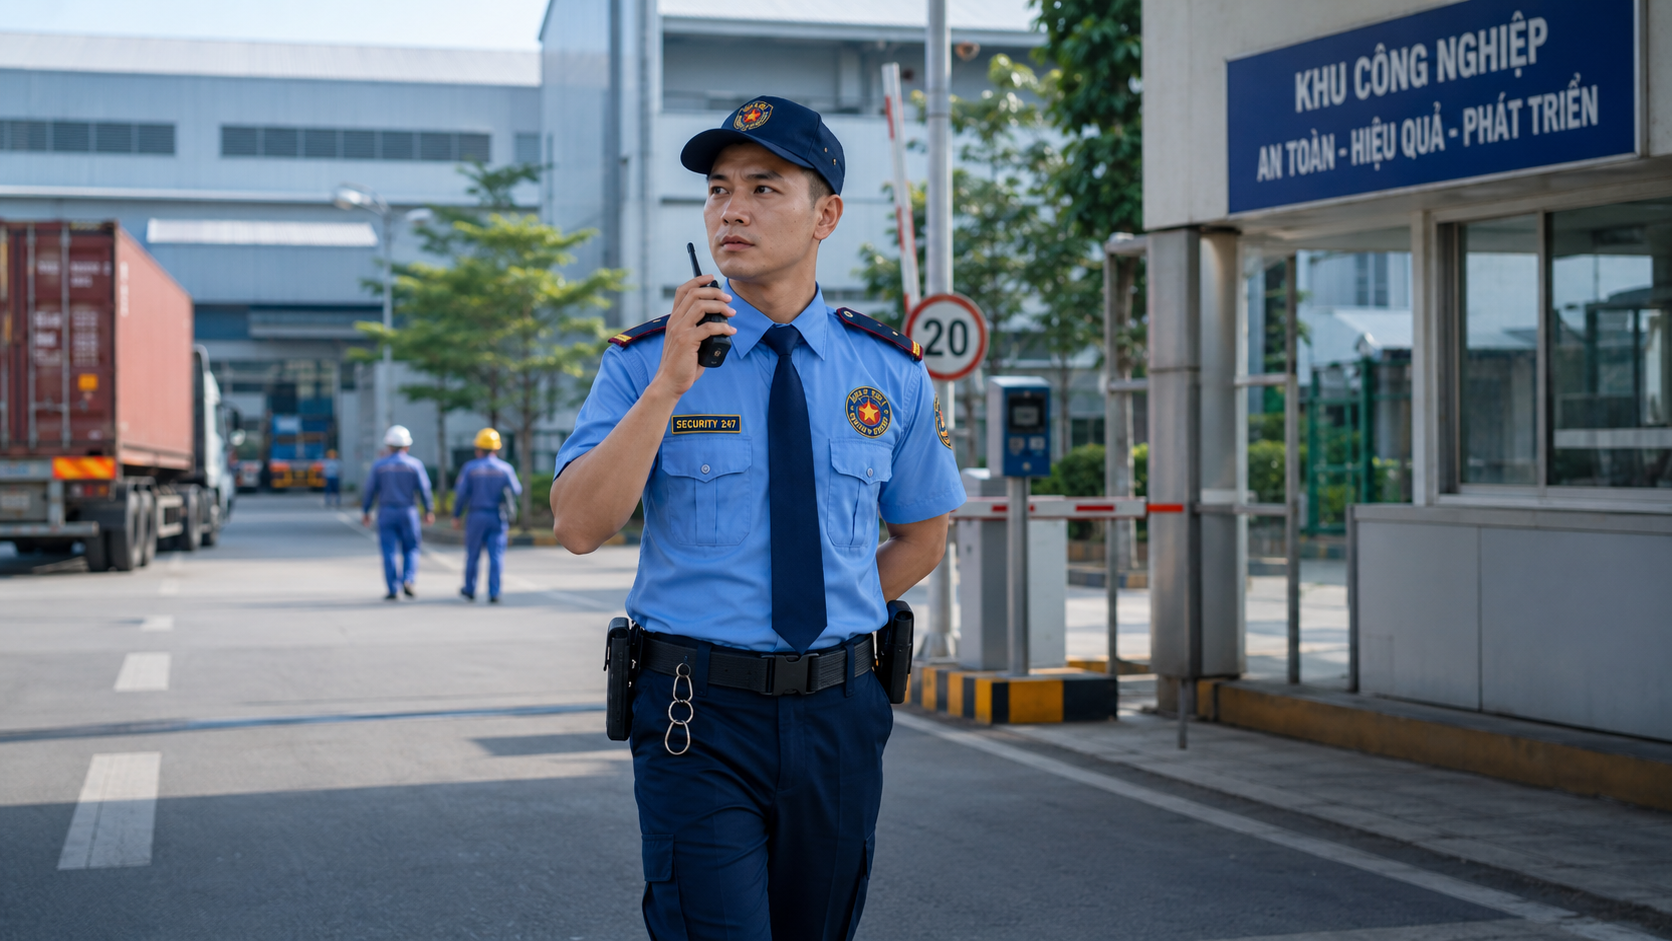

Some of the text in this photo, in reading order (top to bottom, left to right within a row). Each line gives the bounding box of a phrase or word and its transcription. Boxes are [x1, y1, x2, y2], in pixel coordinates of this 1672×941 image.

[1295, 10, 1548, 114] KHU CÔNG NGHIỆP
[1256, 142, 1283, 183] AN
[1285, 127, 1335, 178] TOÀN
[1351, 116, 1396, 172] HIỆU
[1401, 101, 1446, 160] QUẢ
[1463, 91, 1523, 147] PHÁT
[1527, 72, 1598, 135] TRIỂN
[924, 318, 968, 357] 20
[676, 419, 718, 429] SECURITY
